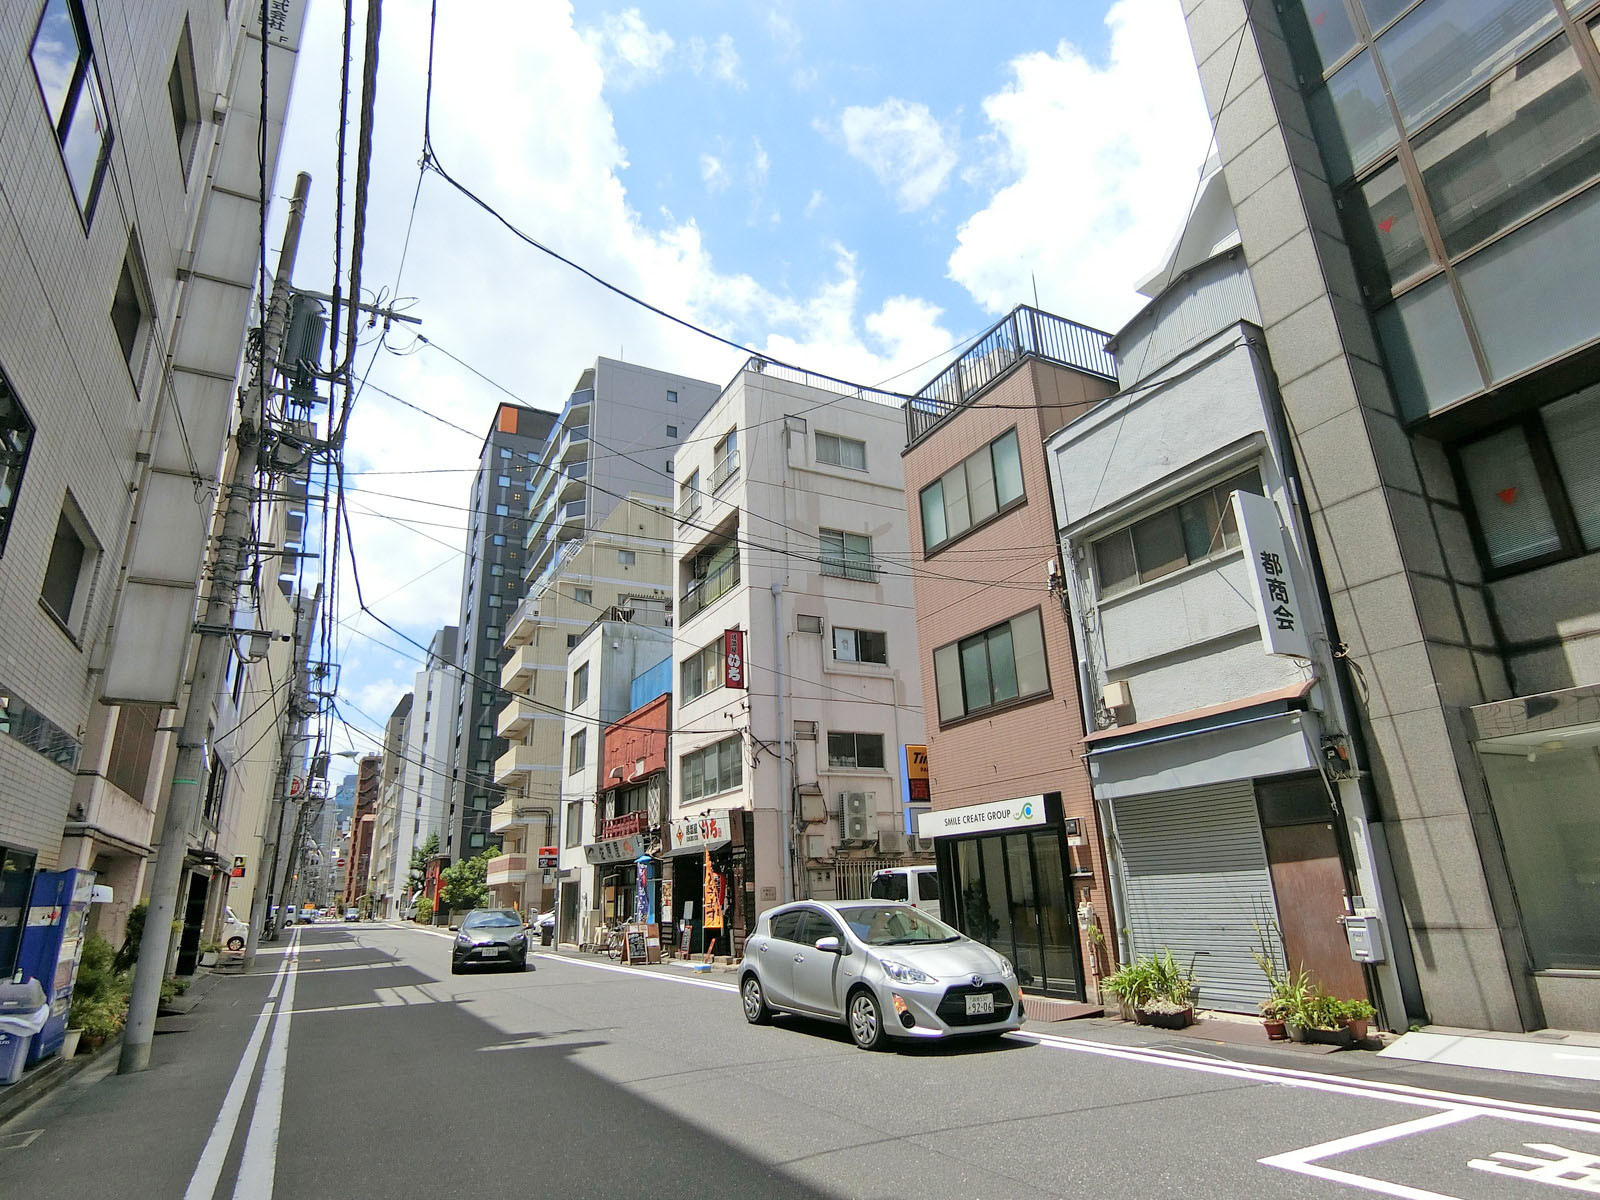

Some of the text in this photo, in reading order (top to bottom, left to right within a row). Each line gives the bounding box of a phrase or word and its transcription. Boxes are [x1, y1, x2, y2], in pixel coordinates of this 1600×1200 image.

[1260, 550, 1295, 632] 都商会
[944, 809, 1011, 827] SMILE CREATE GROUP
[972, 1002, 992, 1013] 92-06
